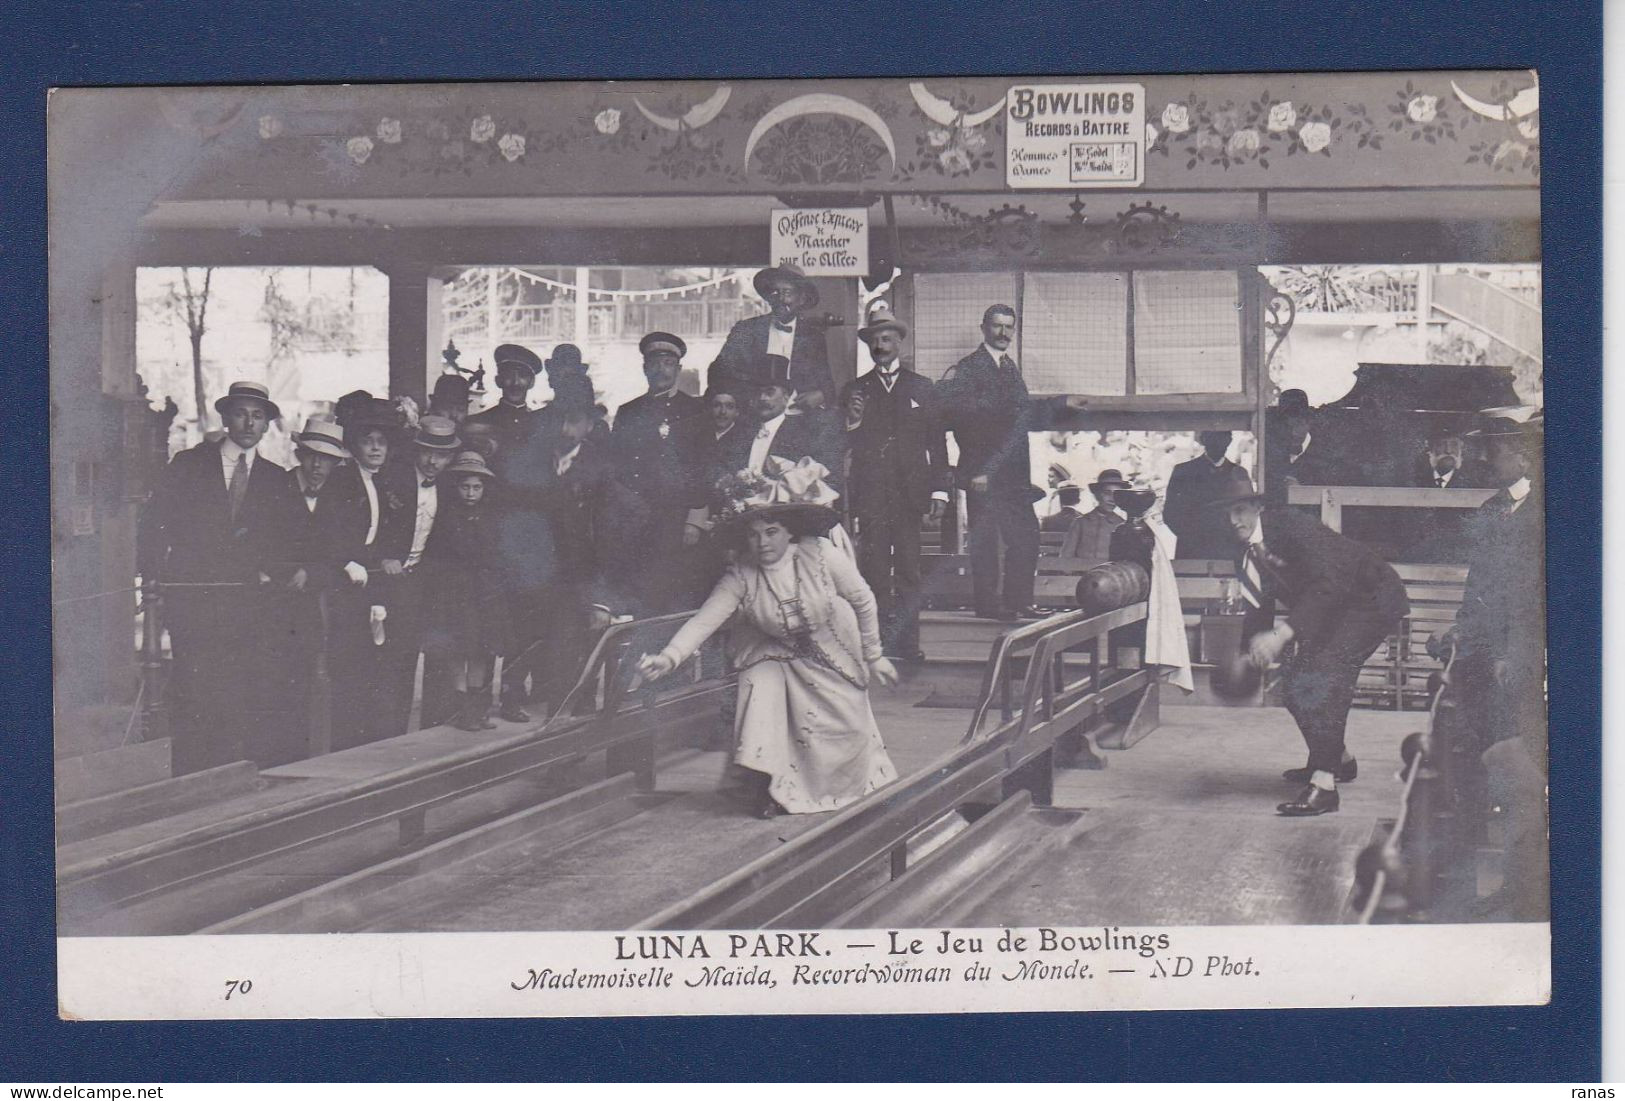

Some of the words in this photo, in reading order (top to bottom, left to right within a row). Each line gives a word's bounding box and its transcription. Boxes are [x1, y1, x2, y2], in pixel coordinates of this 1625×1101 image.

[1010, 88, 1134, 120] BOWLINGS
[1025, 121, 1071, 137] RECORDS
[1082, 120, 1130, 136] BATTRE
[1011, 147, 1058, 162] Hommes
[794, 233, 851, 249] Marcher
[802, 251, 817, 267] les
